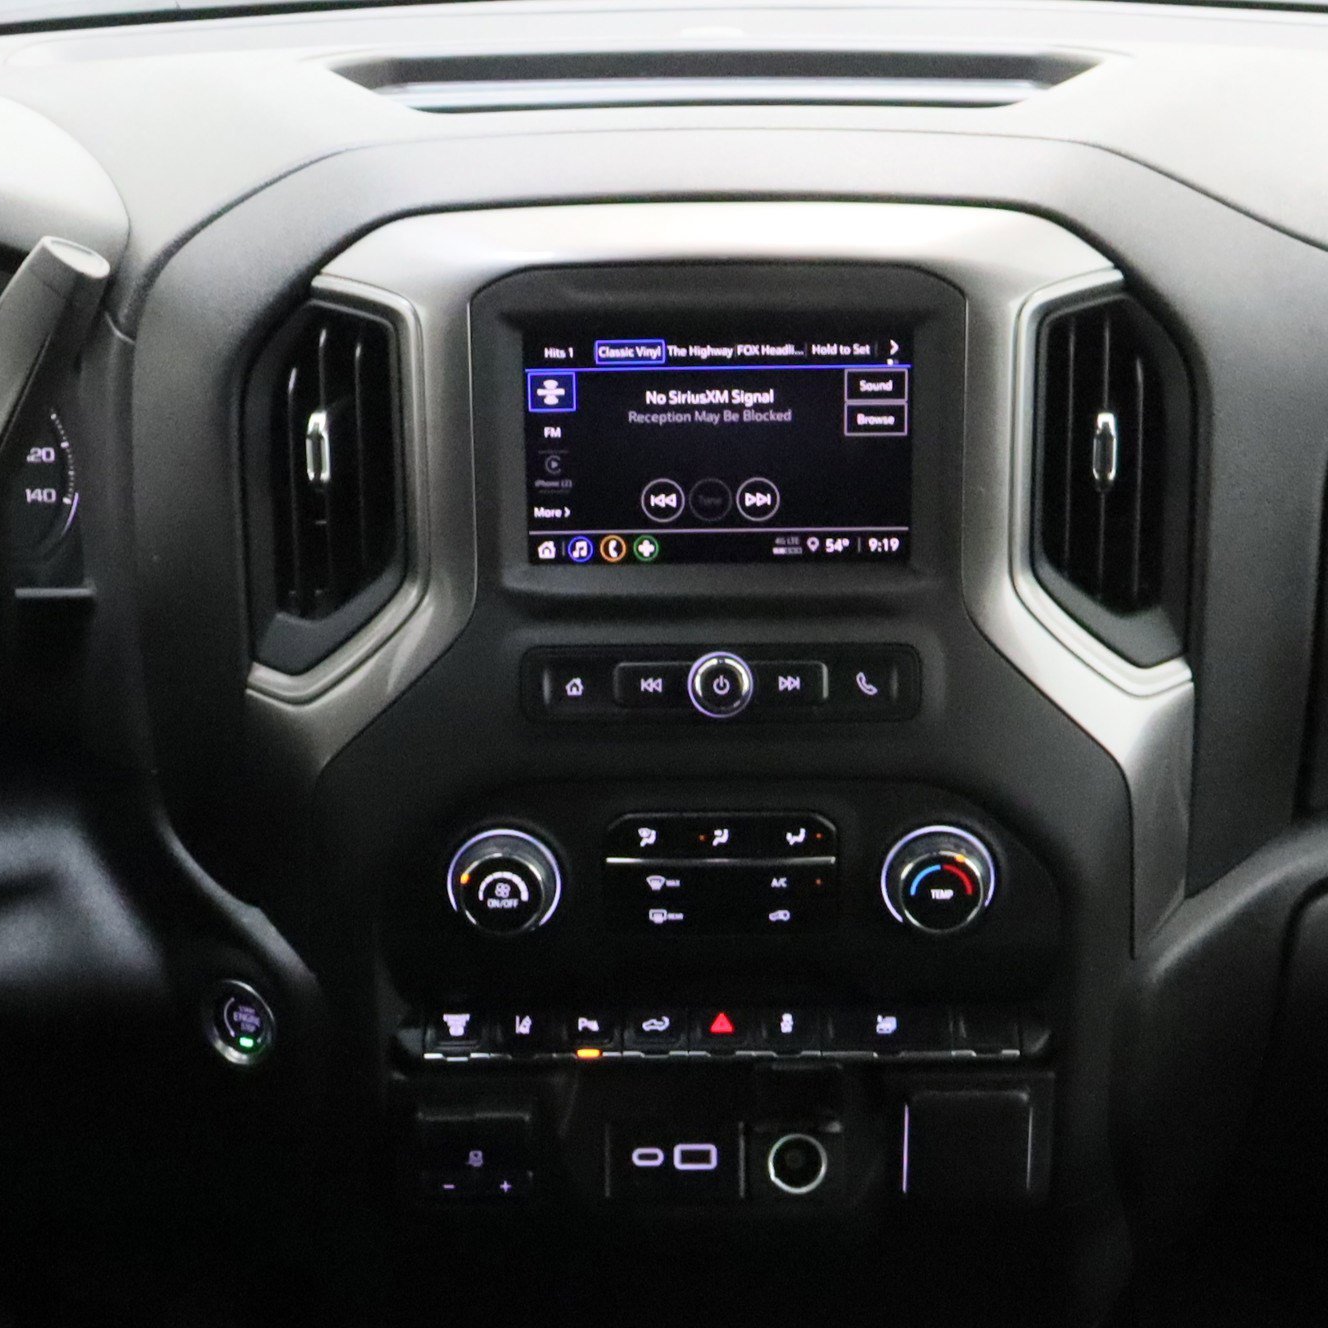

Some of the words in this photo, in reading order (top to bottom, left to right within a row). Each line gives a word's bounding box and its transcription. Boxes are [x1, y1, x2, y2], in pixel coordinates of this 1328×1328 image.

[544, 347, 566, 359] Hits
[598, 346, 635, 359] Classic
[636, 345, 662, 360] Vinyl
[667, 345, 688, 357] The
[689, 343, 734, 359] Highway
[737, 344, 760, 356] FOX
[812, 344, 838, 356] Hold
[840, 344, 850, 355] to
[853, 343, 871, 355] Set
[859, 380, 893, 392] Sound
[646, 391, 667, 405] No
[669, 389, 729, 405] SiriusXM
[731, 388, 774, 407] Signal
[628, 411, 692, 425] Reception
[695, 410, 721, 425] May
[723, 410, 740, 422] Be
[743, 409, 792, 422] Blocked
[857, 413, 895, 425] Browse
[544, 427, 562, 438] FM
[25, 488, 57, 503] 140
[534, 506, 562, 518] More
[868, 538, 900, 552] 9:19
[771, 877, 787, 887] A/C
